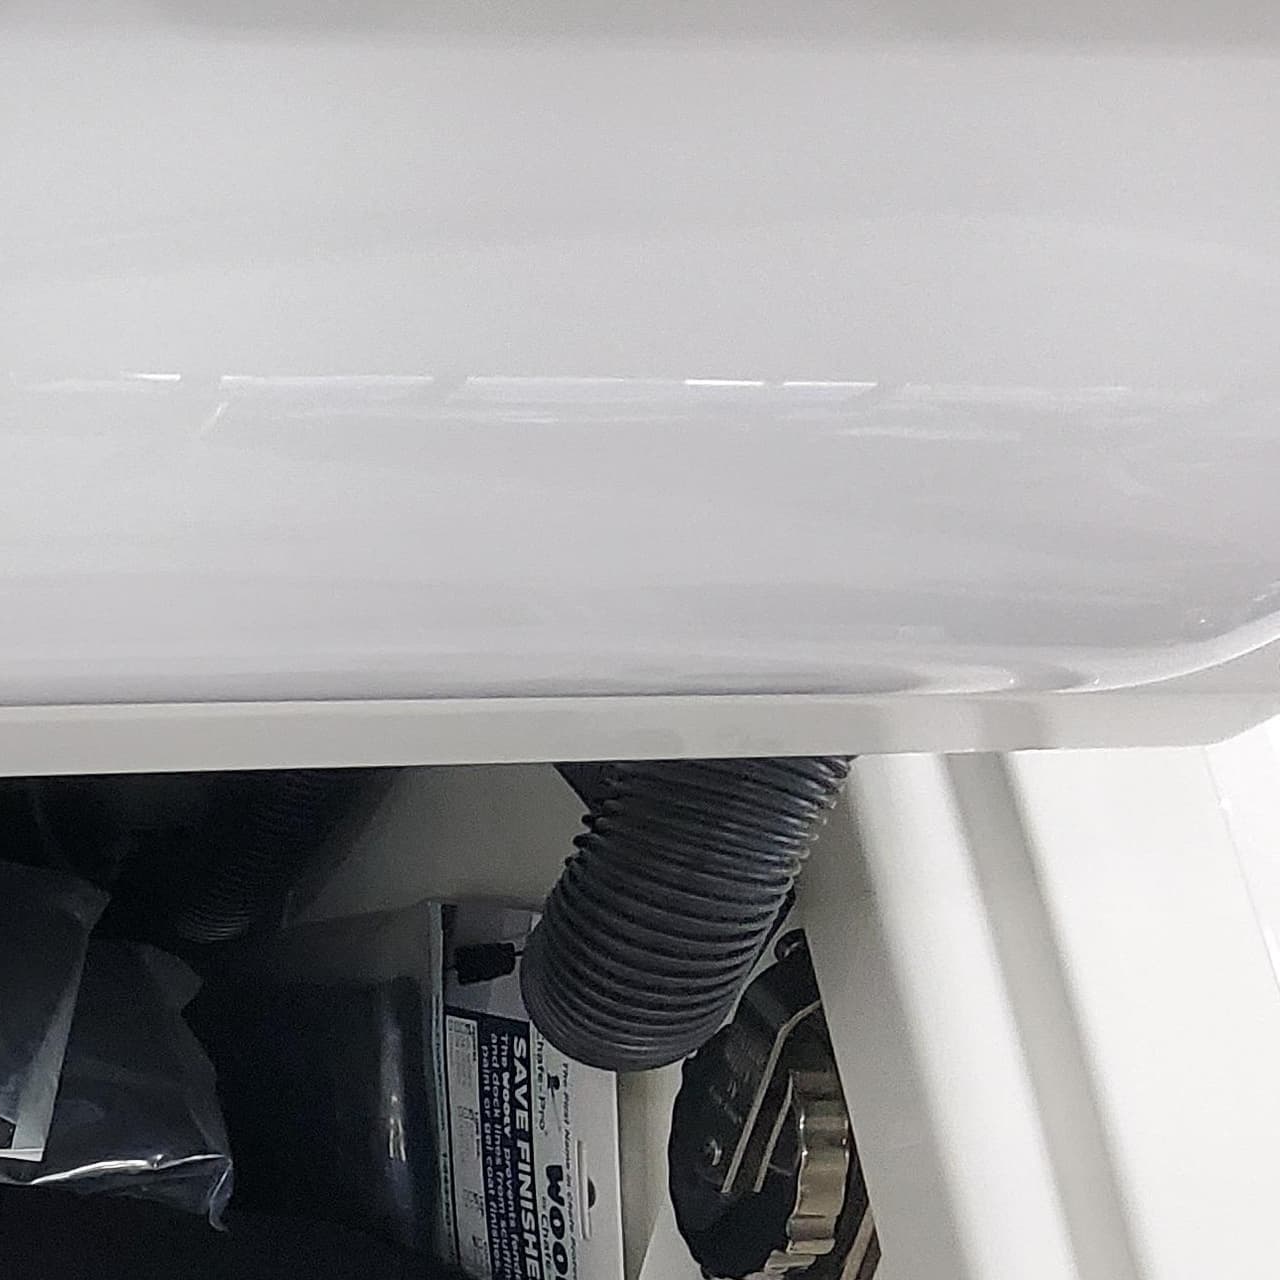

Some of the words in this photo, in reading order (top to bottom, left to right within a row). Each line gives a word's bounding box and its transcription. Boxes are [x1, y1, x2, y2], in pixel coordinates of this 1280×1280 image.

[481, 1045, 491, 1091] paint
[491, 1033, 500, 1068] and
[492, 1073, 501, 1118] dock
[514, 1036, 529, 1132] SAVE
[484, 1097, 491, 1118] or
[484, 1123, 494, 1151] gel
[494, 1124, 503, 1166] lines
[486, 1156, 496, 1196] coat
[496, 1171, 505, 1214] from
[504, 1148, 516, 1228] prevents
